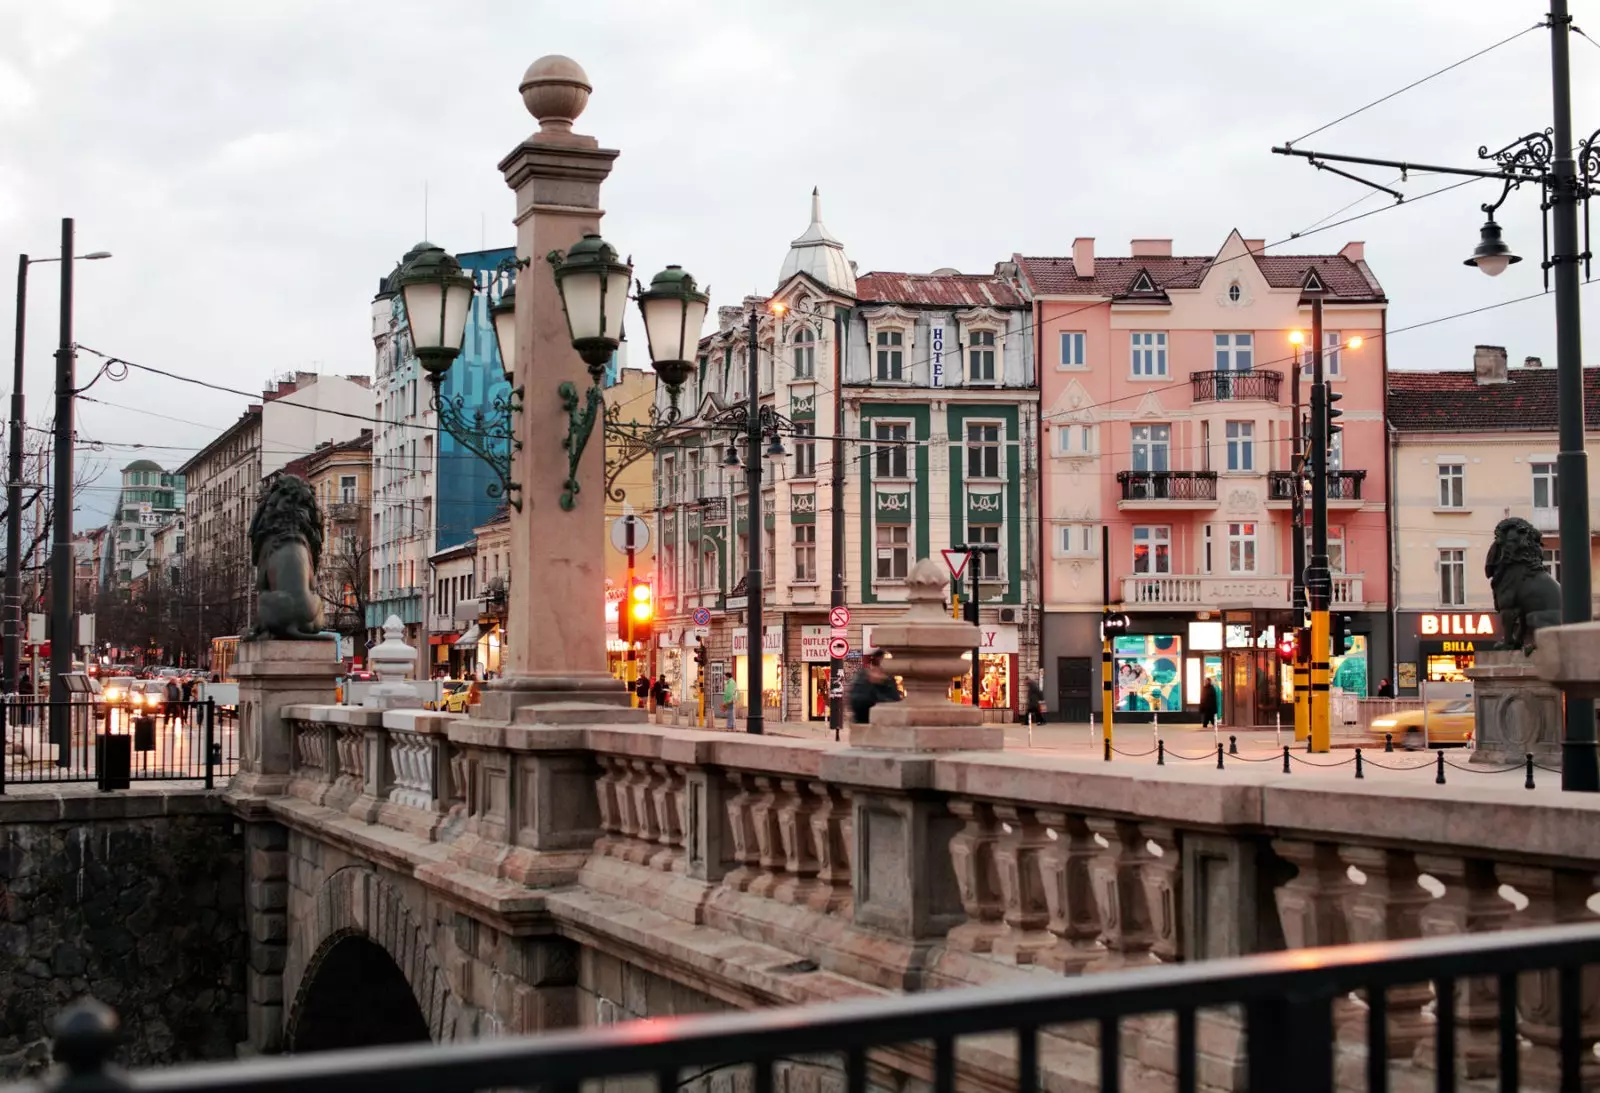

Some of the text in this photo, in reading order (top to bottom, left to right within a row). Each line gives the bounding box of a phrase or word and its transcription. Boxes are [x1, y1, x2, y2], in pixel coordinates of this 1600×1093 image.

[933, 328, 943, 387] HOTEL
[1421, 614, 1494, 635] BILLA
[802, 637, 830, 646] OUTLET
[1443, 641, 1475, 652] BILLA
[805, 649, 828, 657] ITALY
